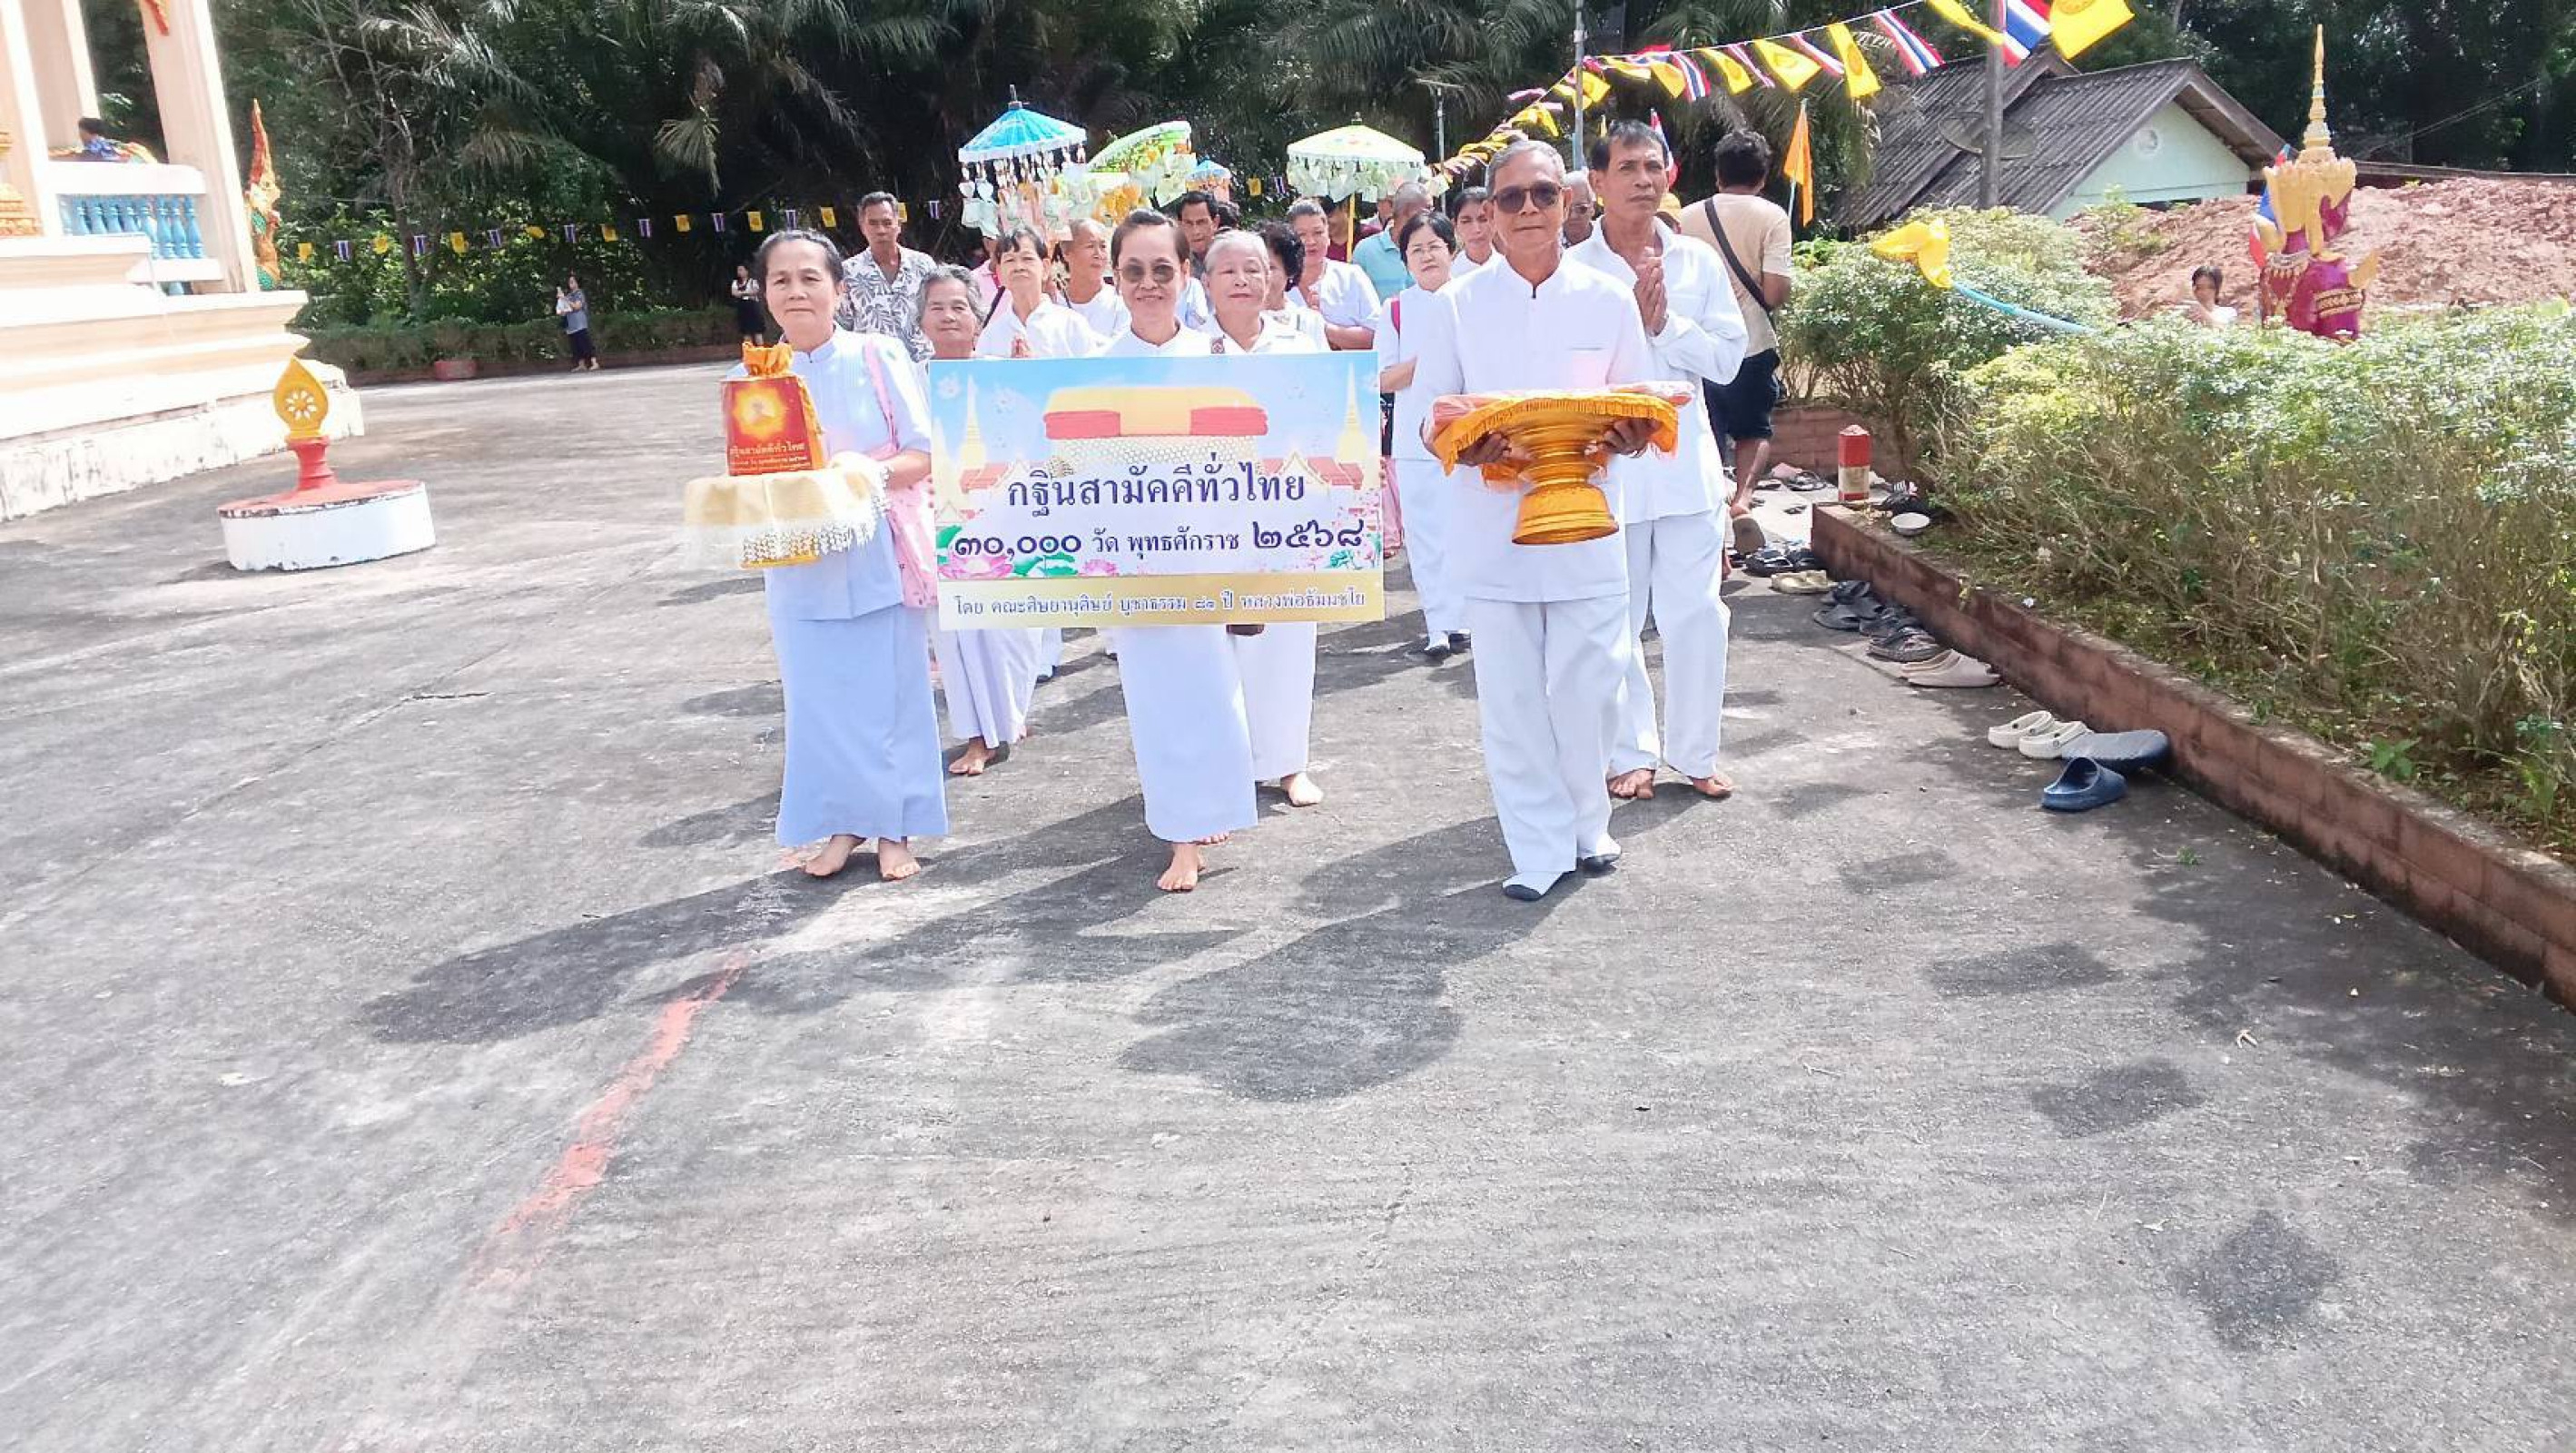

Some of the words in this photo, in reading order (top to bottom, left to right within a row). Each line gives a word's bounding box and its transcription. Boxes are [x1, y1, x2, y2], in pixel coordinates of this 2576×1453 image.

[1008, 452, 1304, 517] กฐินสามัคคีทั่วไทย
[954, 535, 1081, 560] ๓๐,๐๐๐
[1091, 528, 1119, 552] วัด
[1128, 526, 1239, 559] พุทธศักราช
[1252, 519, 1364, 549] ๒๕๖๘
[954, 595, 983, 615] โดย
[992, 593, 1112, 616] คณะศิษยานุศิษย์
[1120, 598, 1187, 616] บูชาธรรม
[1221, 590, 1234, 609] ปี
